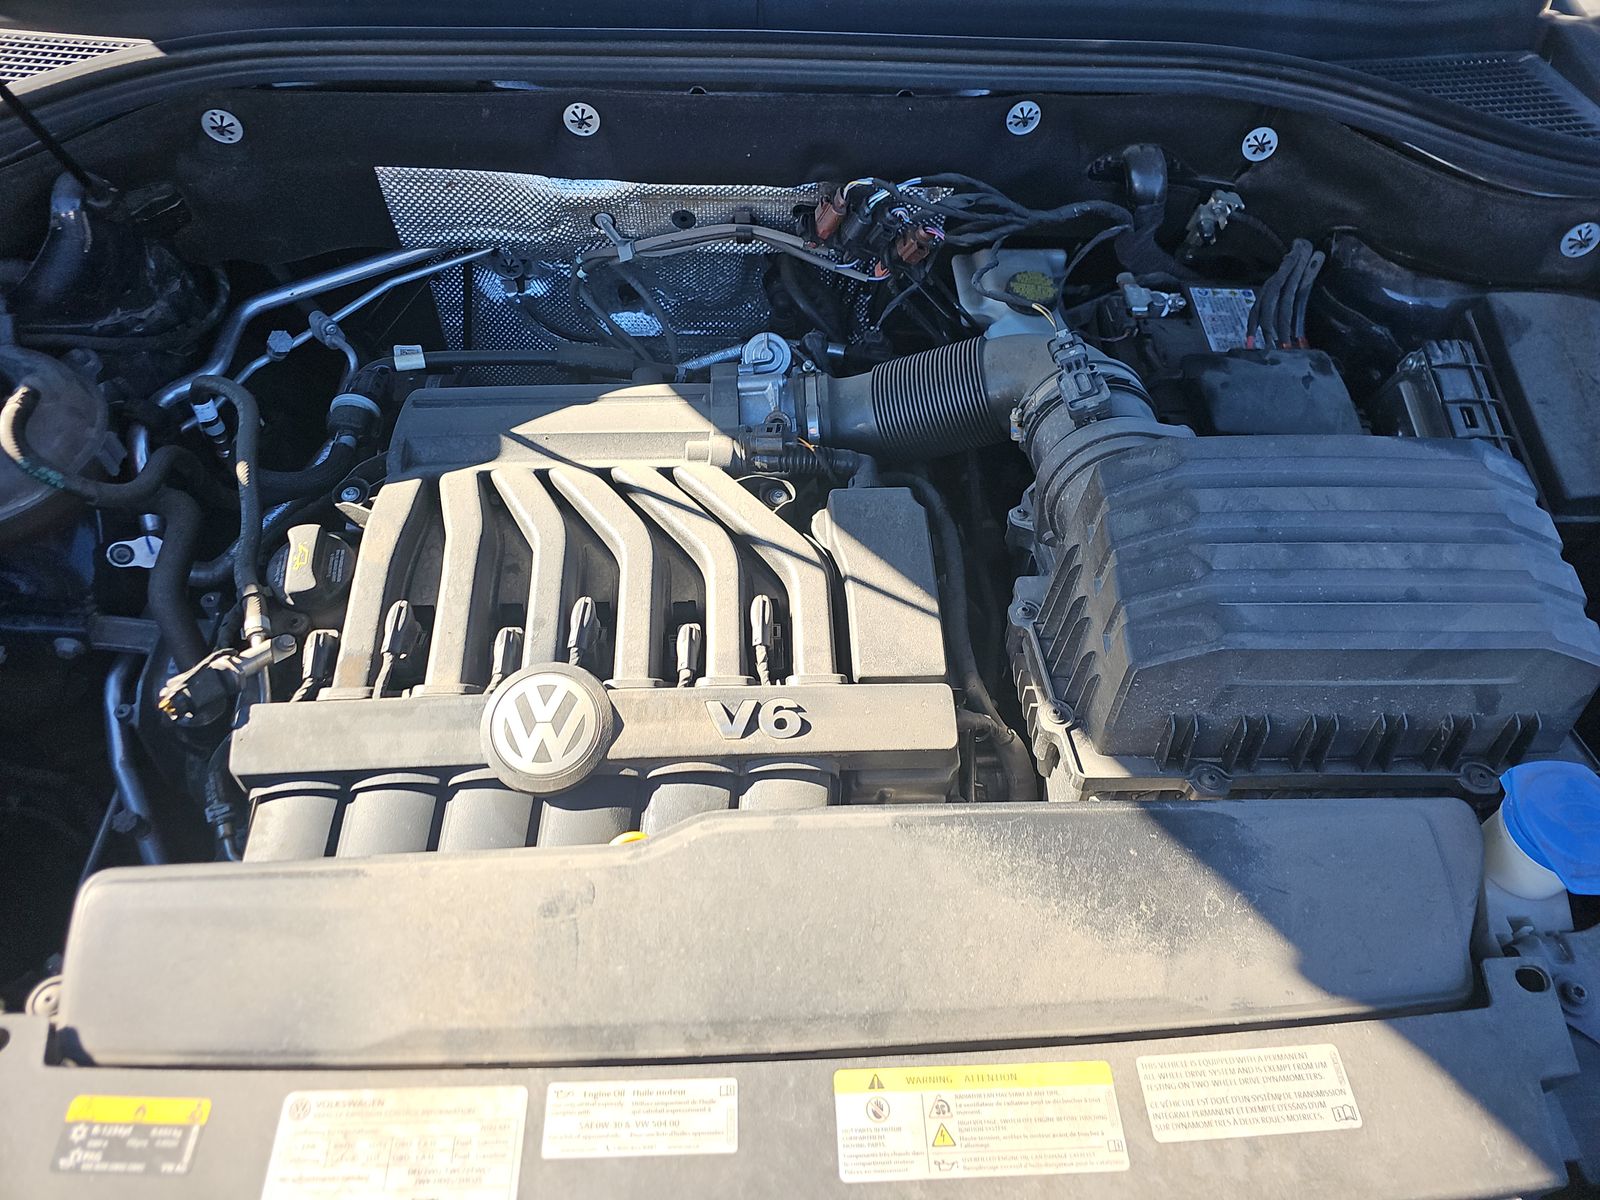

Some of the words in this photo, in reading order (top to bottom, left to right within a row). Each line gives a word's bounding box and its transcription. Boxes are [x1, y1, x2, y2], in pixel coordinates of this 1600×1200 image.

[705, 697, 802, 739] V6
[1141, 1062, 1157, 1070] THIS
[1158, 1060, 1188, 1069] VEHICLE
[1190, 1059, 1198, 1067] IS
[1198, 1057, 1235, 1067] EQUIPPED
[1235, 1055, 1257, 1064] WITH
[1264, 1052, 1308, 1062] PERMANENT
[1184, 1069, 1207, 1078] DRIVE
[1208, 1067, 1236, 1077] SYSTEM
[1237, 1066, 1254, 1074] AND
[1255, 1065, 1263, 1073] IS
[1263, 1064, 1291, 1072] EXEMPT
[1292, 1062, 1314, 1070] FROM
[905, 1076, 953, 1085] WARNING
[964, 1073, 1017, 1083] ATTENTION
[1146, 1081, 1177, 1091] TESTING
[1177, 1081, 1191, 1090] ON
[1238, 1076, 1260, 1085] DRIVE
[583, 1090, 612, 1100] Engine
[613, 1089, 625, 1098] Oil
[633, 1088, 654, 1097] Huile
[656, 1088, 686, 1097] moteur
[1196, 1097, 1209, 1106] EST
[1283, 1091, 1292, 1100] DE
[1293, 1088, 1347, 1099] TRANSMISSION
[316, 1098, 385, 1108] VOLKSWAGEN
[1192, 1108, 1235, 1118] PERMANENT
[1236, 1106, 1244, 1115] ET
[635, 1119, 650, 1128] VW
[651, 1119, 667, 1128] 504
[669, 1119, 680, 1128] 00
[1155, 1123, 1170, 1132] SUR
[1238, 1117, 1260, 1126] DEUX
[1261, 1115, 1286, 1125] ROUES
